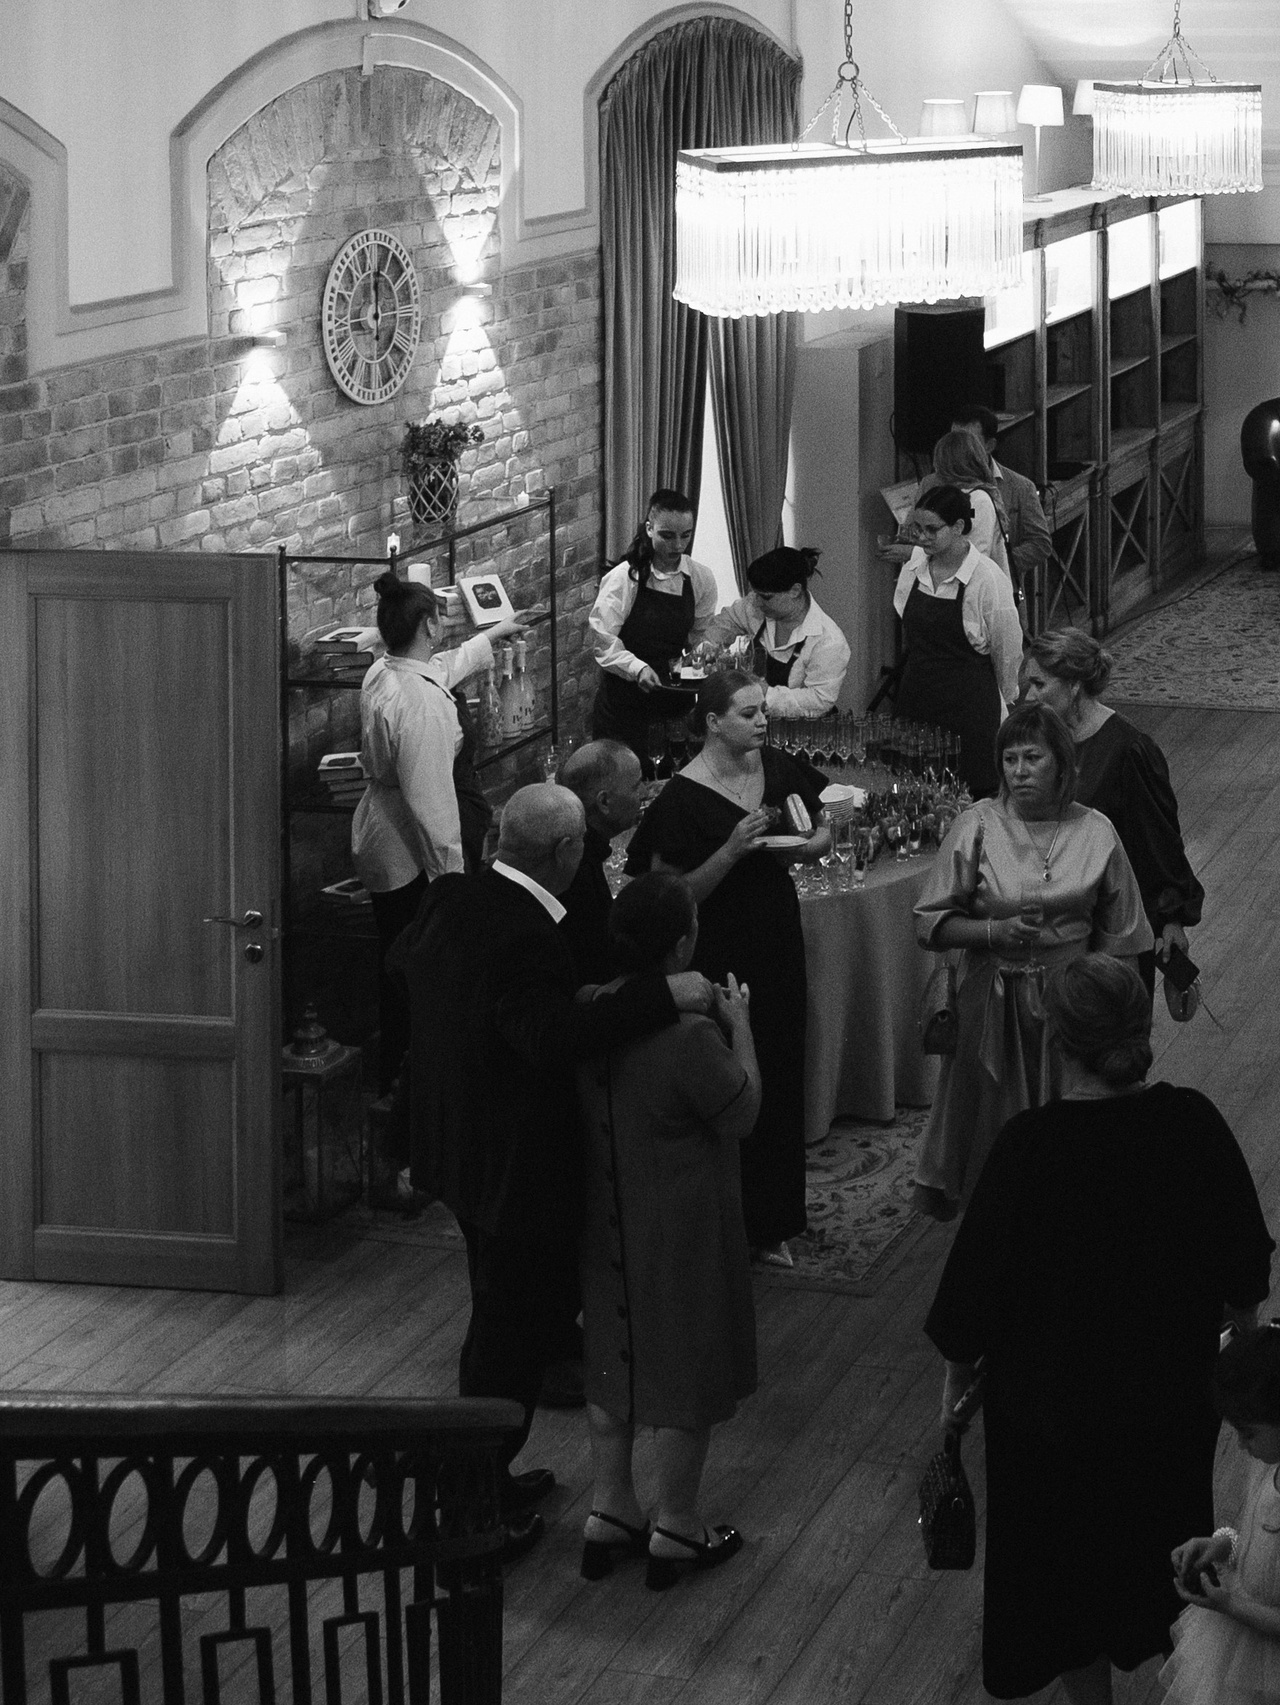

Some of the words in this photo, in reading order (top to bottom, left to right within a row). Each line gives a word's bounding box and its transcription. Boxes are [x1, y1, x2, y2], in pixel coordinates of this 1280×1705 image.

[364, 244, 378, 272] XII
[394, 271, 409, 292] II
[398, 304, 414, 317] III
